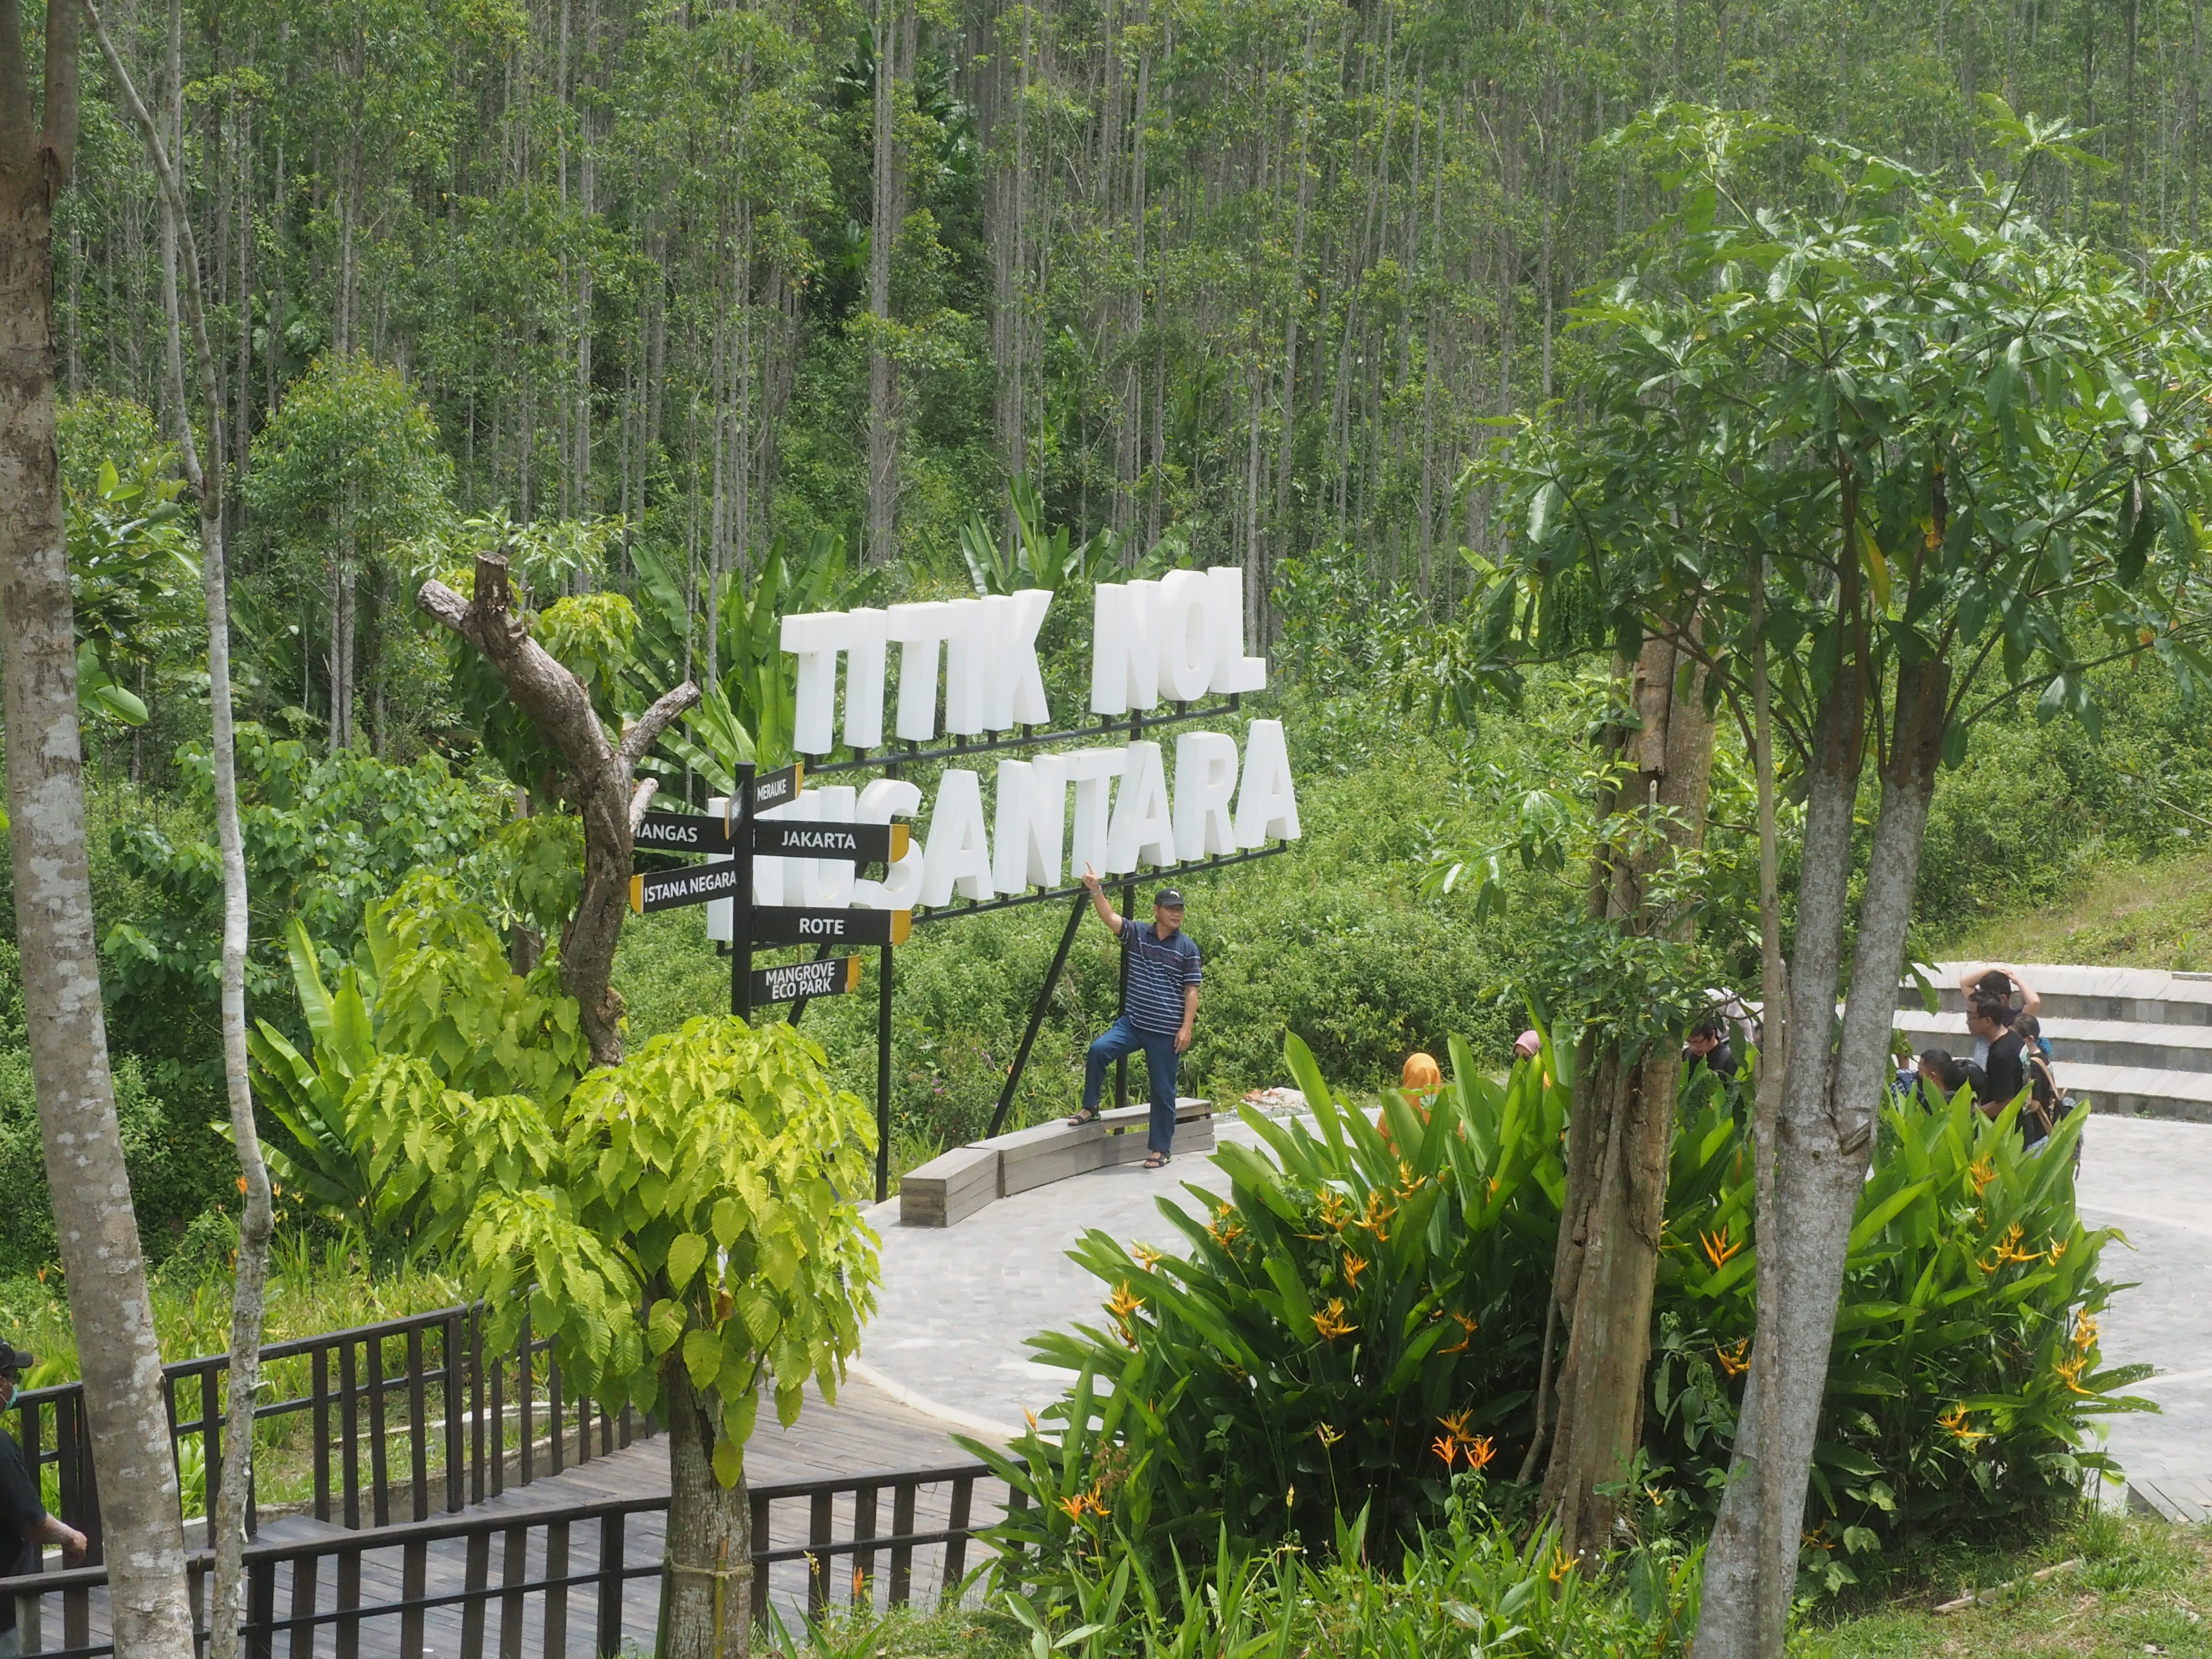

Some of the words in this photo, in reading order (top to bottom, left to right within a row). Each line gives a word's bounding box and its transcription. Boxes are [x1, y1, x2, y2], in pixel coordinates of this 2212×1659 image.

[781, 589, 1054, 754] TITIK
[1091, 566, 1266, 715] NOL
[757, 779, 786, 802] MERAUKE
[636, 823, 697, 842] IANGAS
[781, 831, 856, 849] JAKARTA
[644, 880, 688, 903] ISTANA
[690, 870, 737, 894] NEGARA
[799, 918, 844, 934] ROTE
[766, 961, 835, 986] MANGROVE
[772, 982, 796, 999] ECO
[800, 977, 831, 996] PARK
